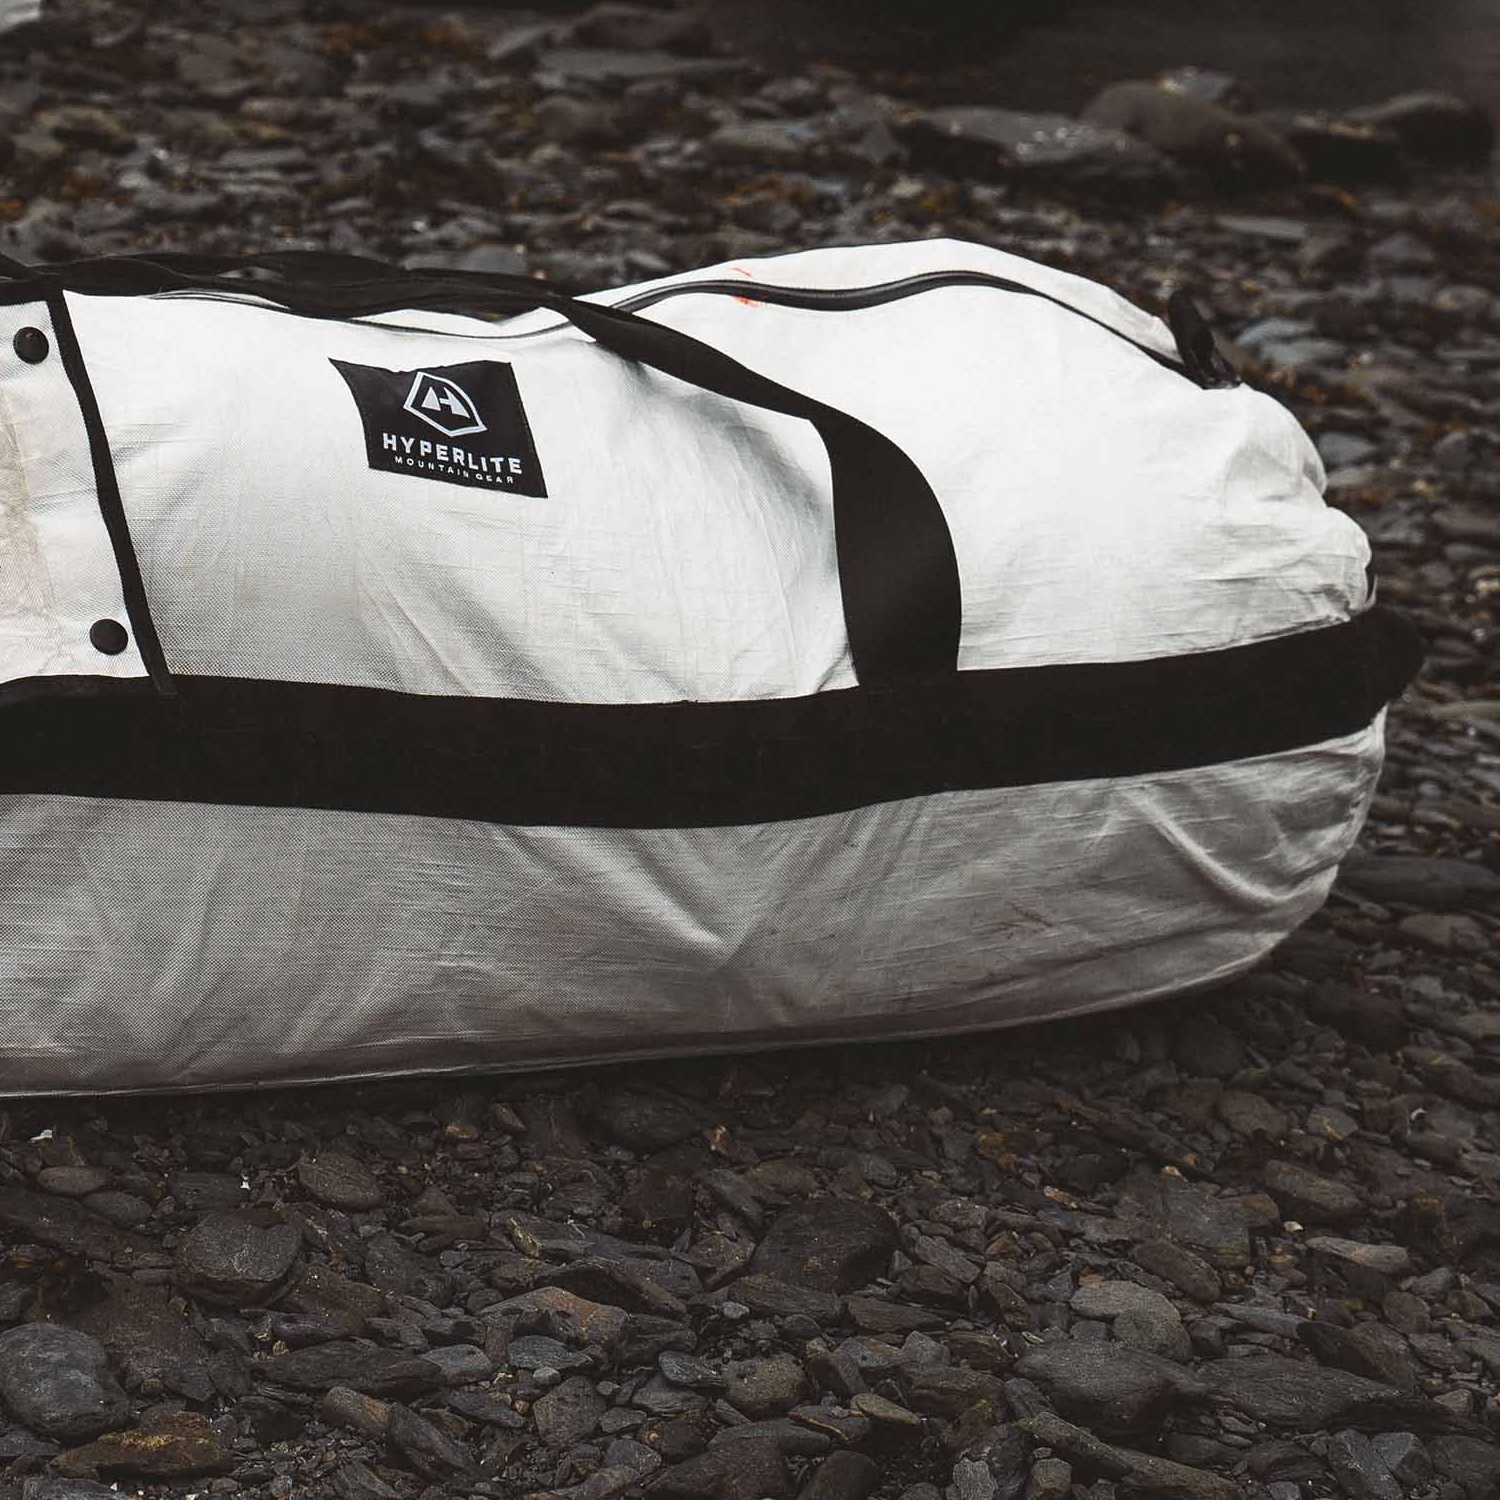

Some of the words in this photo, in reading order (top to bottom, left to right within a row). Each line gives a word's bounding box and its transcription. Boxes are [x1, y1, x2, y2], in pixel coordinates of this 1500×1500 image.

[382, 432, 523, 474] HYPERLITE
[394, 456, 469, 478] MOUNTAIN
[475, 472, 514, 484] GEAR
